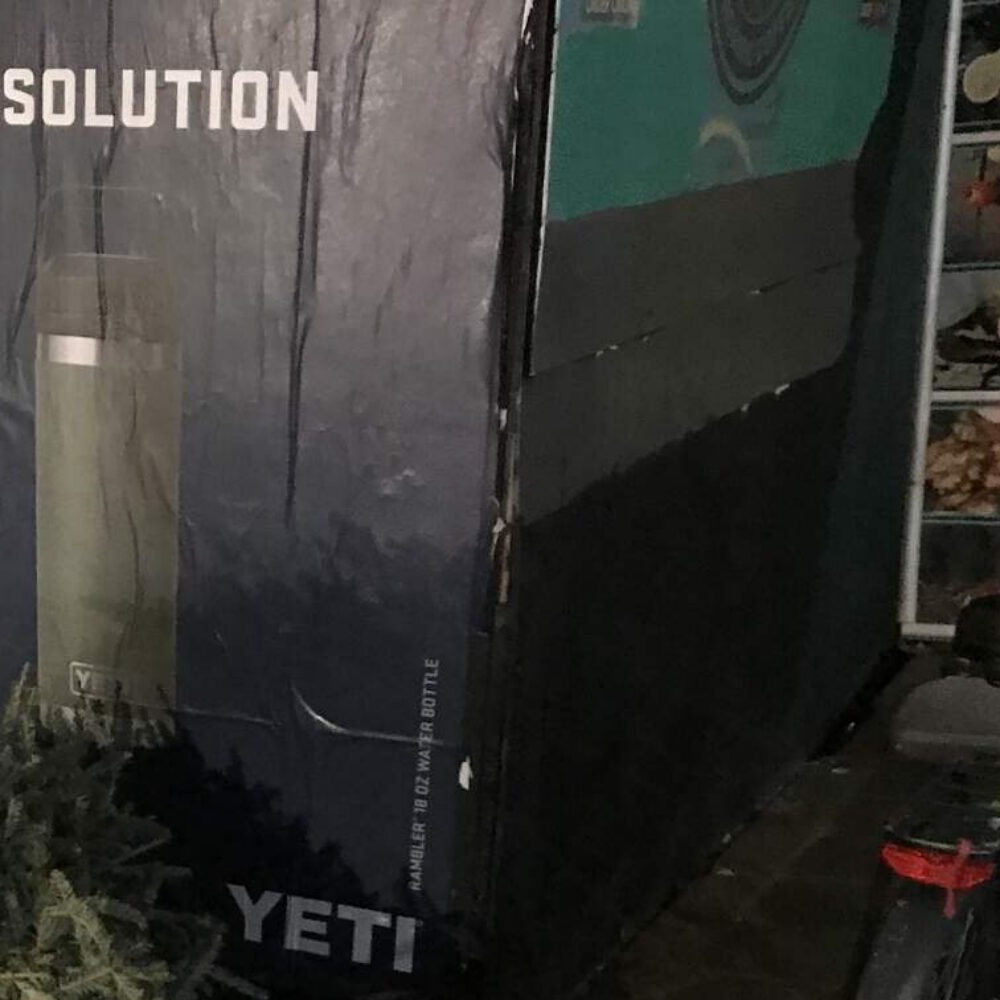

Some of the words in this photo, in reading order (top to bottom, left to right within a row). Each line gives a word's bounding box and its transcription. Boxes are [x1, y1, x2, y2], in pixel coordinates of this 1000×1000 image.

[420, 657, 440, 718] BOTTLE
[412, 798, 428, 813] 18
[414, 774, 431, 796] OZ
[227, 883, 416, 973] YETI
